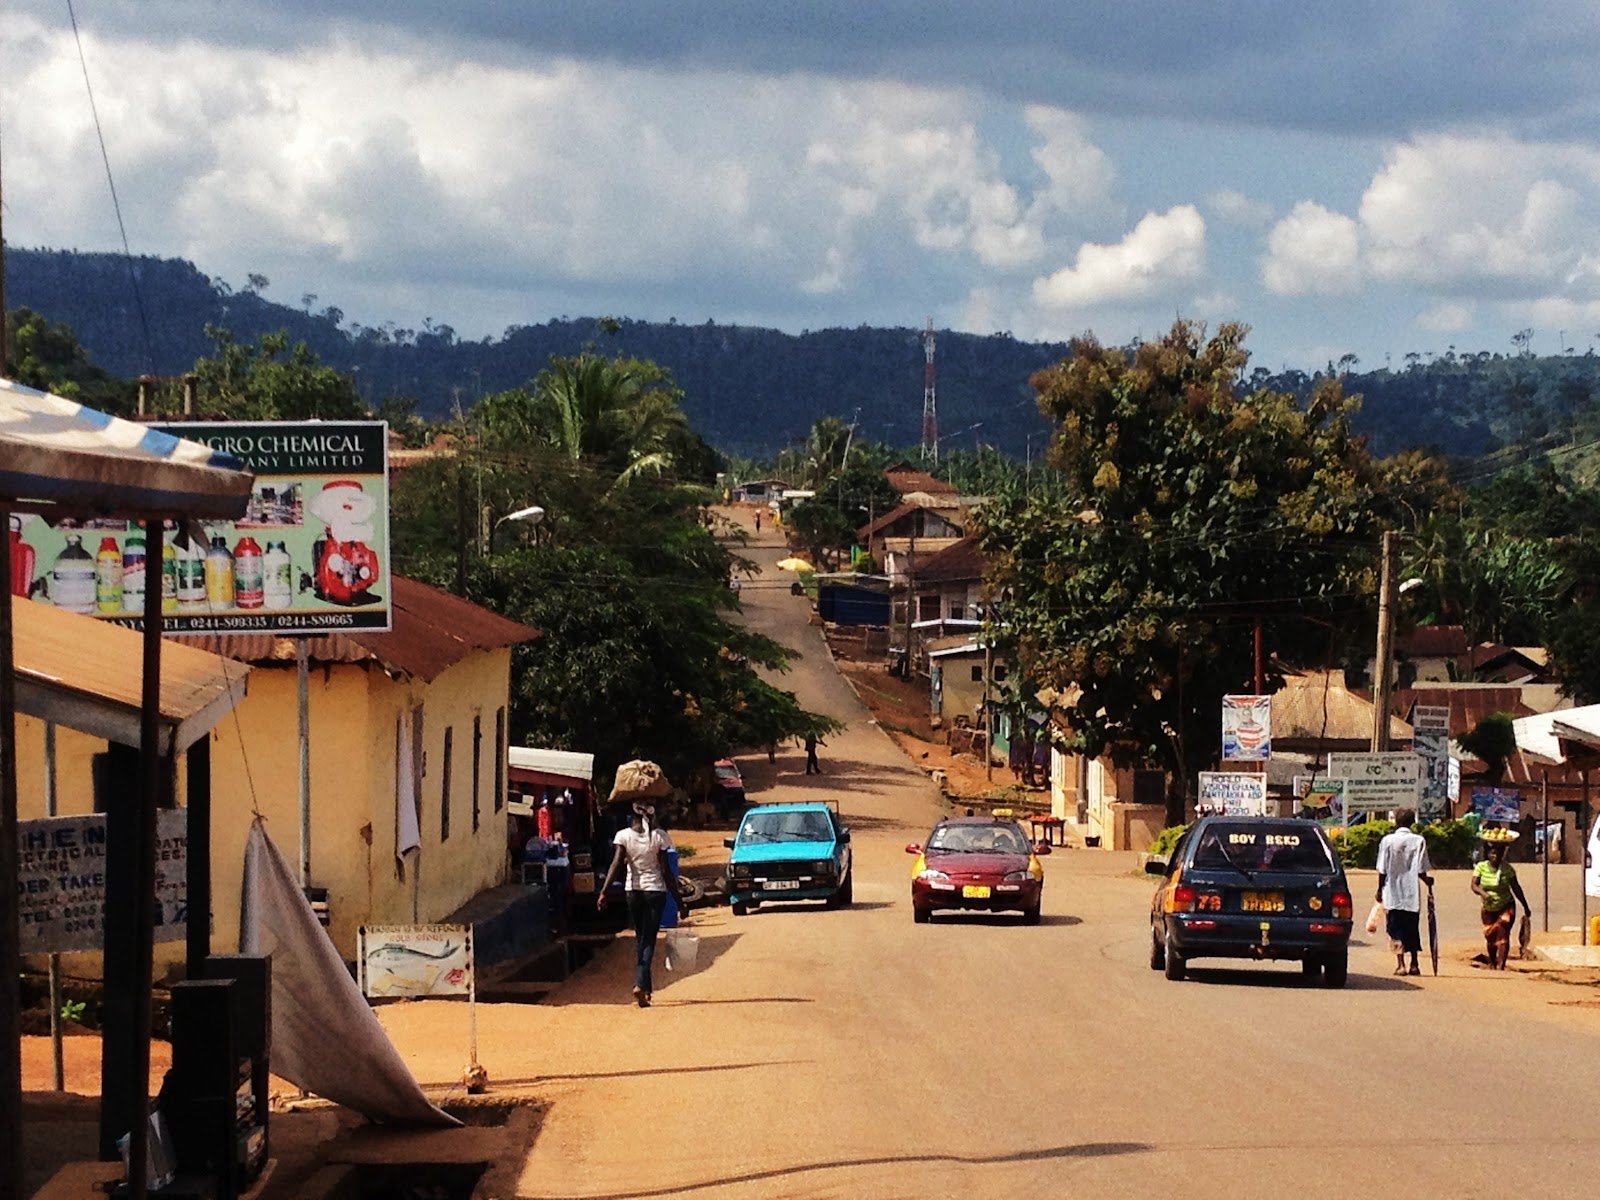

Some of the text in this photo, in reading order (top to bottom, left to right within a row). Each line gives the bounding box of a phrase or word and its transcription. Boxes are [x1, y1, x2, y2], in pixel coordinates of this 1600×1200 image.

[258, 435, 364, 453] CHEMICAL
[290, 455, 363, 467] LIMITED
[1232, 783, 1261, 791] GHANA
[1229, 833, 1256, 844] BOY
